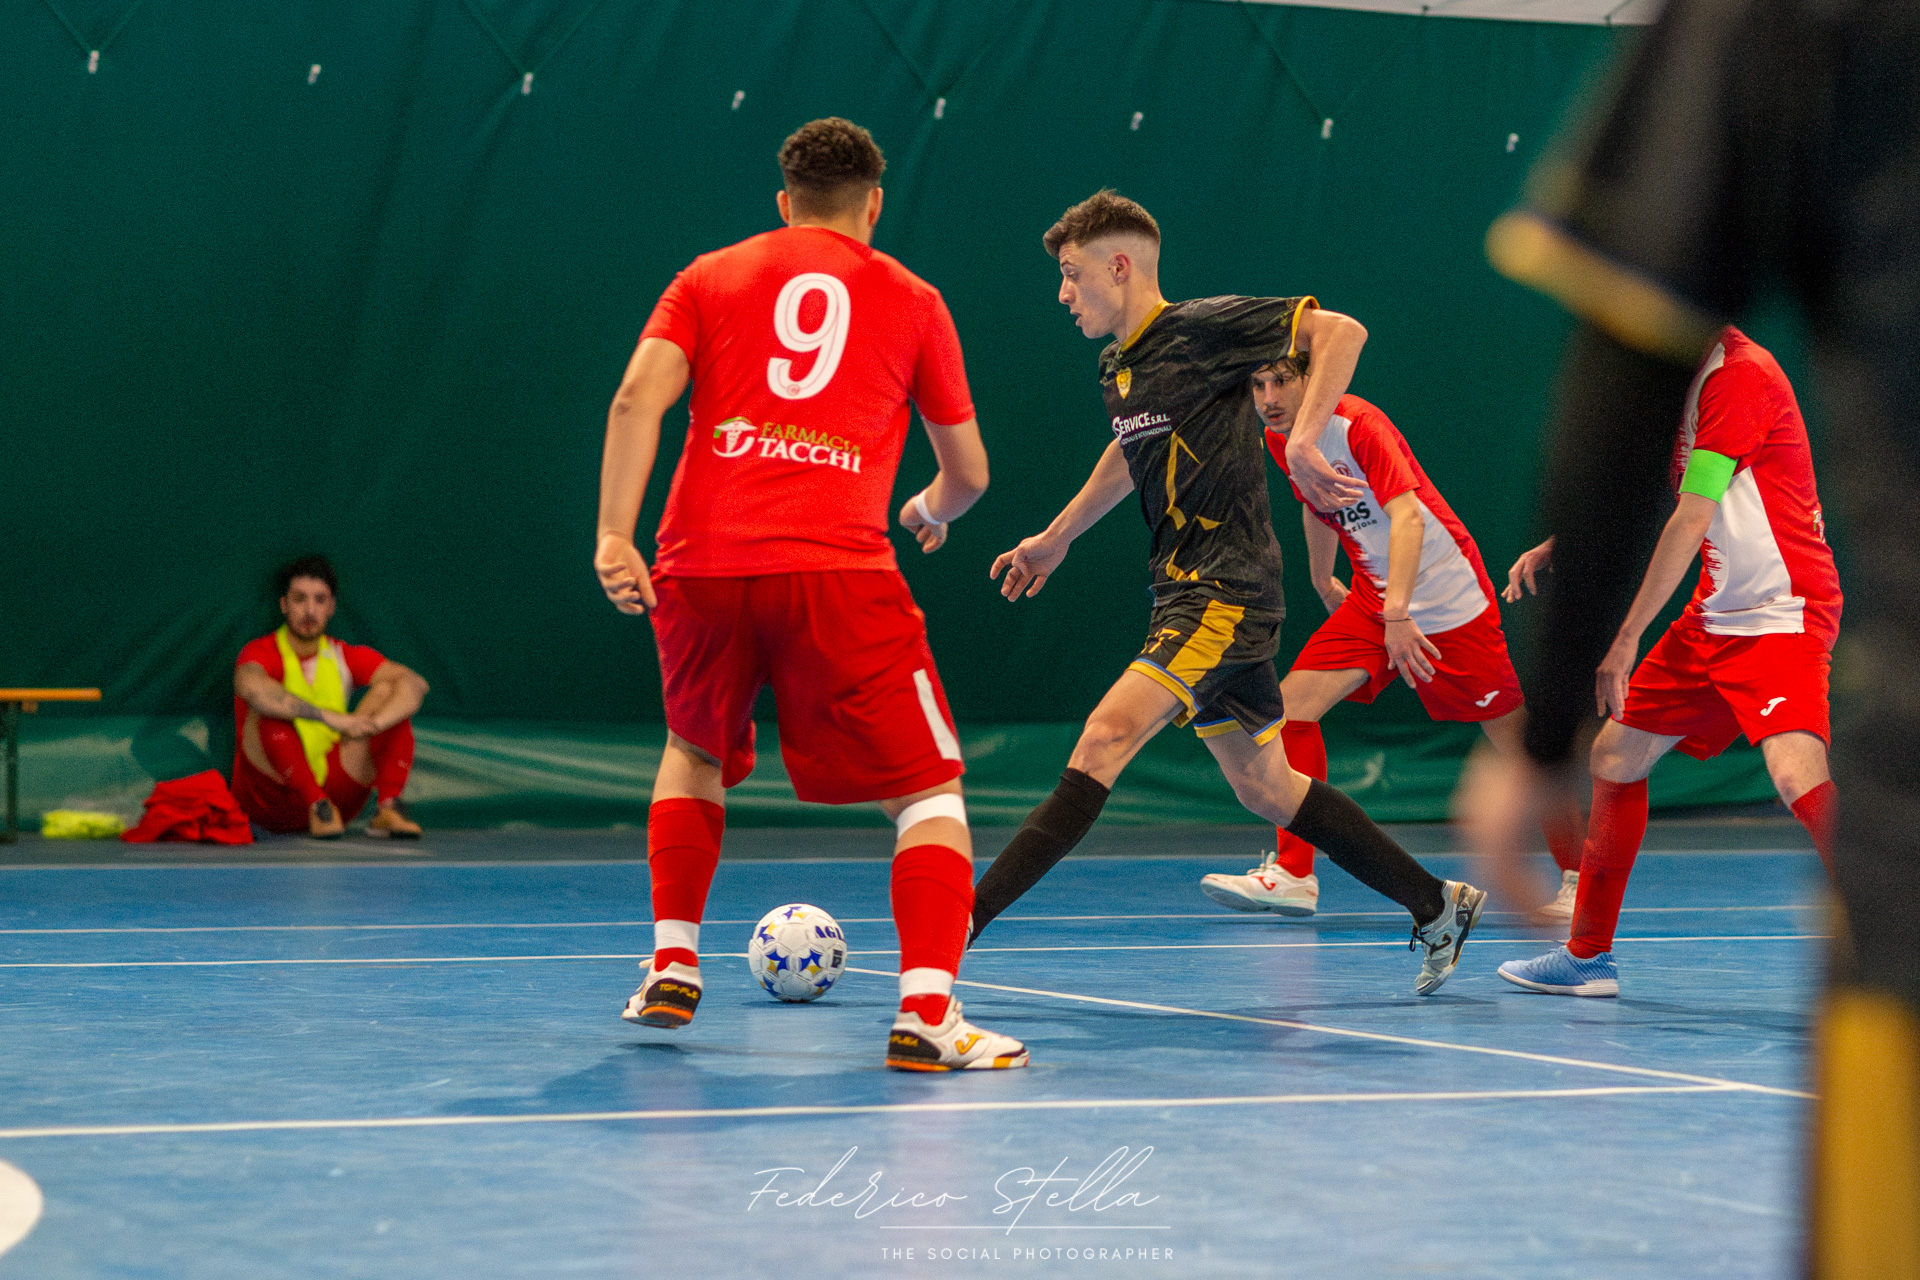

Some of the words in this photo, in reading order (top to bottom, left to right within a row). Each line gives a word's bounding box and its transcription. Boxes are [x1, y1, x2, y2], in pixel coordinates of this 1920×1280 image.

[767, 272, 851, 400] 9
[757, 437, 860, 473] TACCHI
[761, 422, 861, 457] FARMACIA
